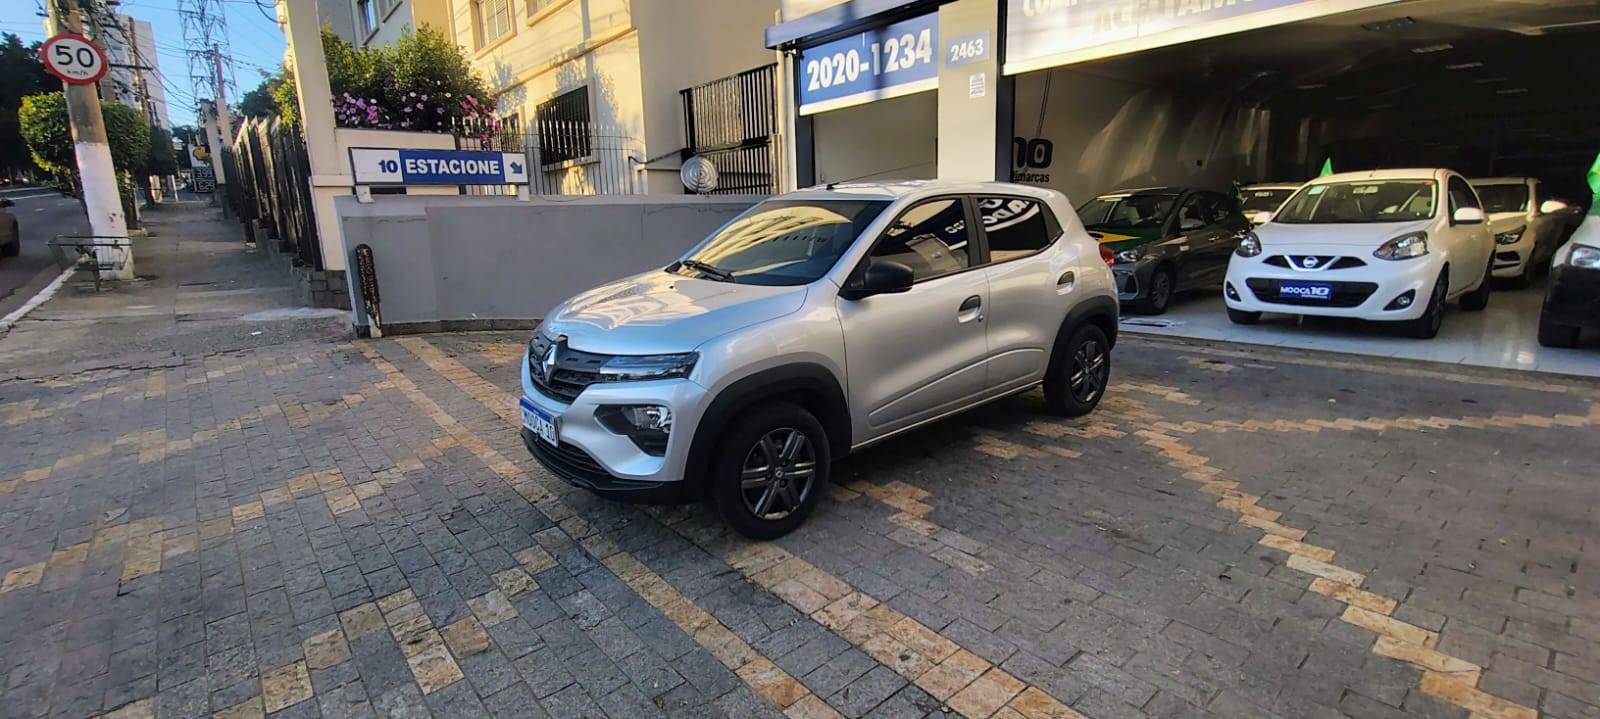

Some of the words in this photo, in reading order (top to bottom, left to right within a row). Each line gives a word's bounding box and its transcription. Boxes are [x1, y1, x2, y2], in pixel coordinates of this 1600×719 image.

[55, 45, 94, 67] 50
[807, 28, 932, 92] 2020-1234
[951, 38, 983, 62] 2463
[1014, 136, 1053, 169] 10
[378, 159, 398, 174] 10
[405, 159, 500, 175] ESTACIONE
